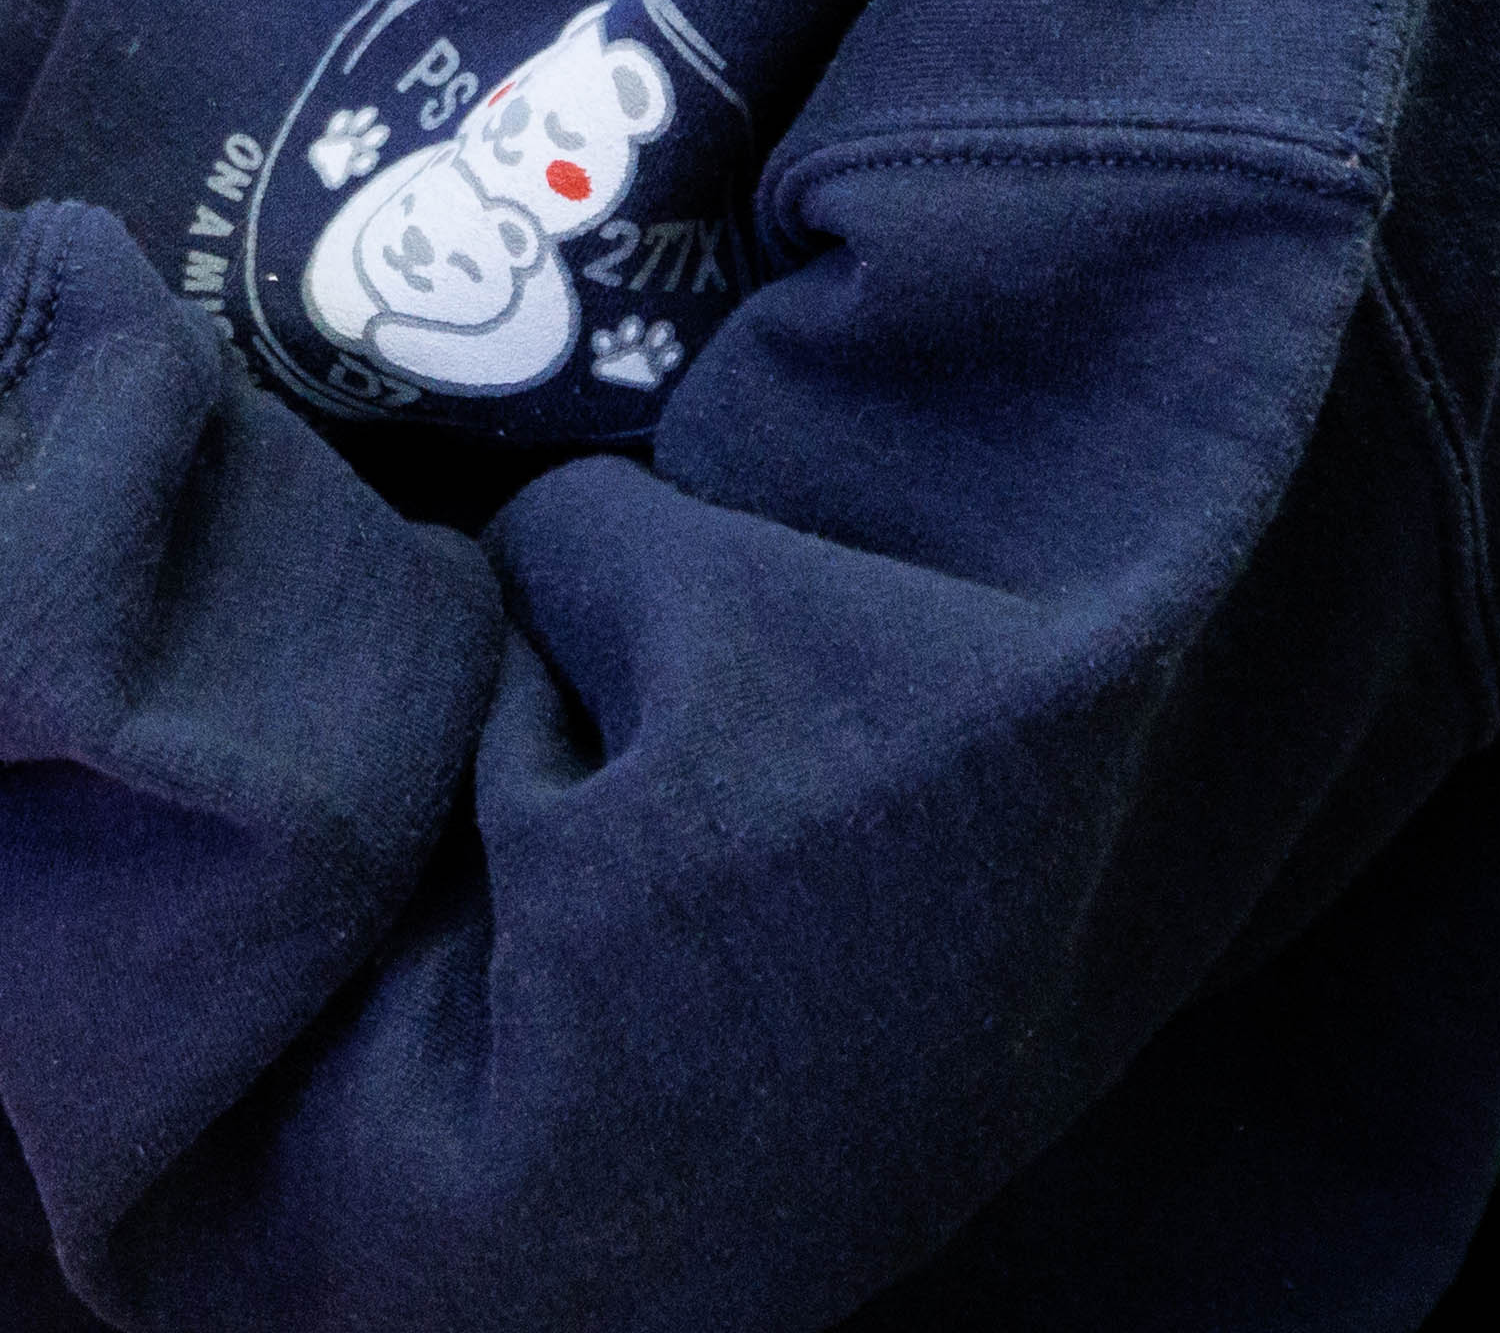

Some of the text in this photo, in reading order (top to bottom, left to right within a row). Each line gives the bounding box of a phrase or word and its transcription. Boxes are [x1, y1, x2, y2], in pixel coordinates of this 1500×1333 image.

[206, 133, 264, 202] ON
[397, 37, 729, 295] PS 277X
[189, 204, 236, 238] A
